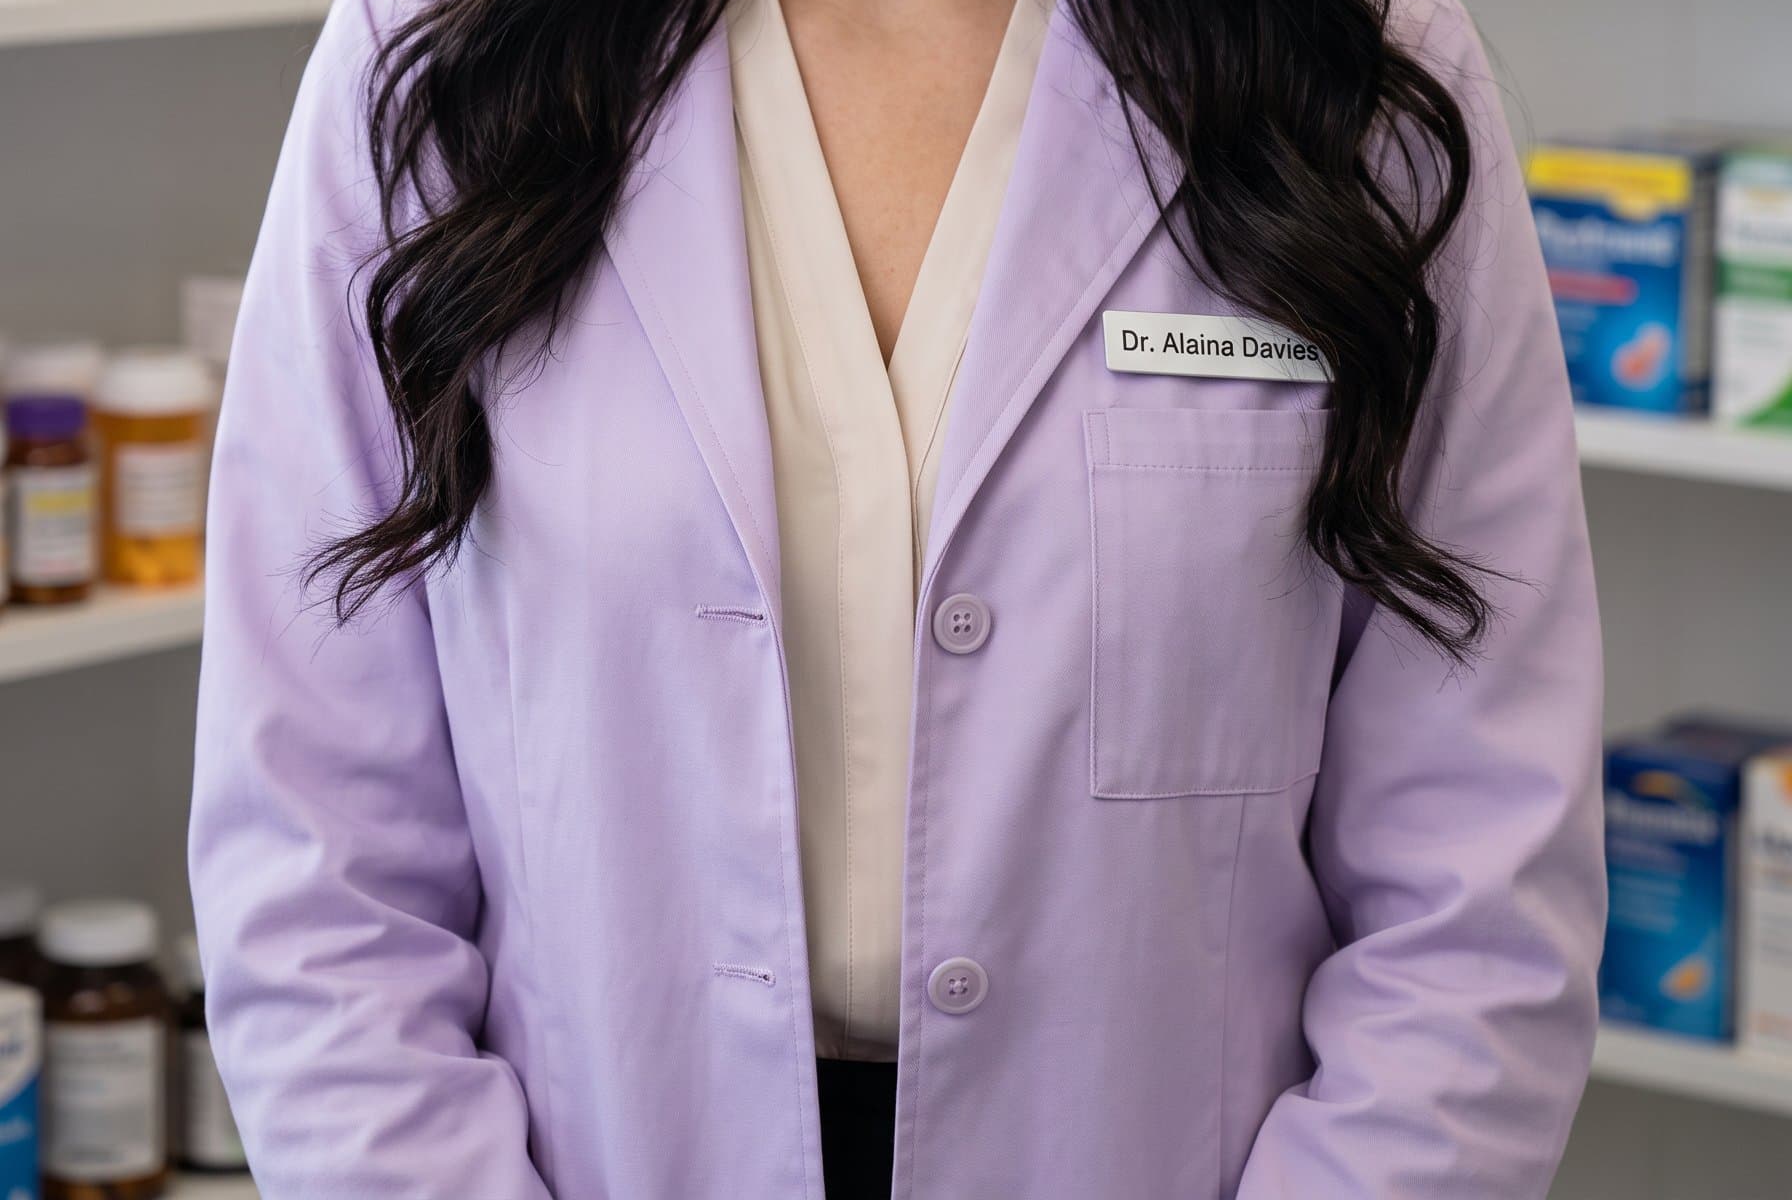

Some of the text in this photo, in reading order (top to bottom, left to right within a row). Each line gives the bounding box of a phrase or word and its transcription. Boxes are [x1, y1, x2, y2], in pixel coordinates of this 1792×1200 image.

[1122, 330, 1319, 361] Dr. Alaina Davies
